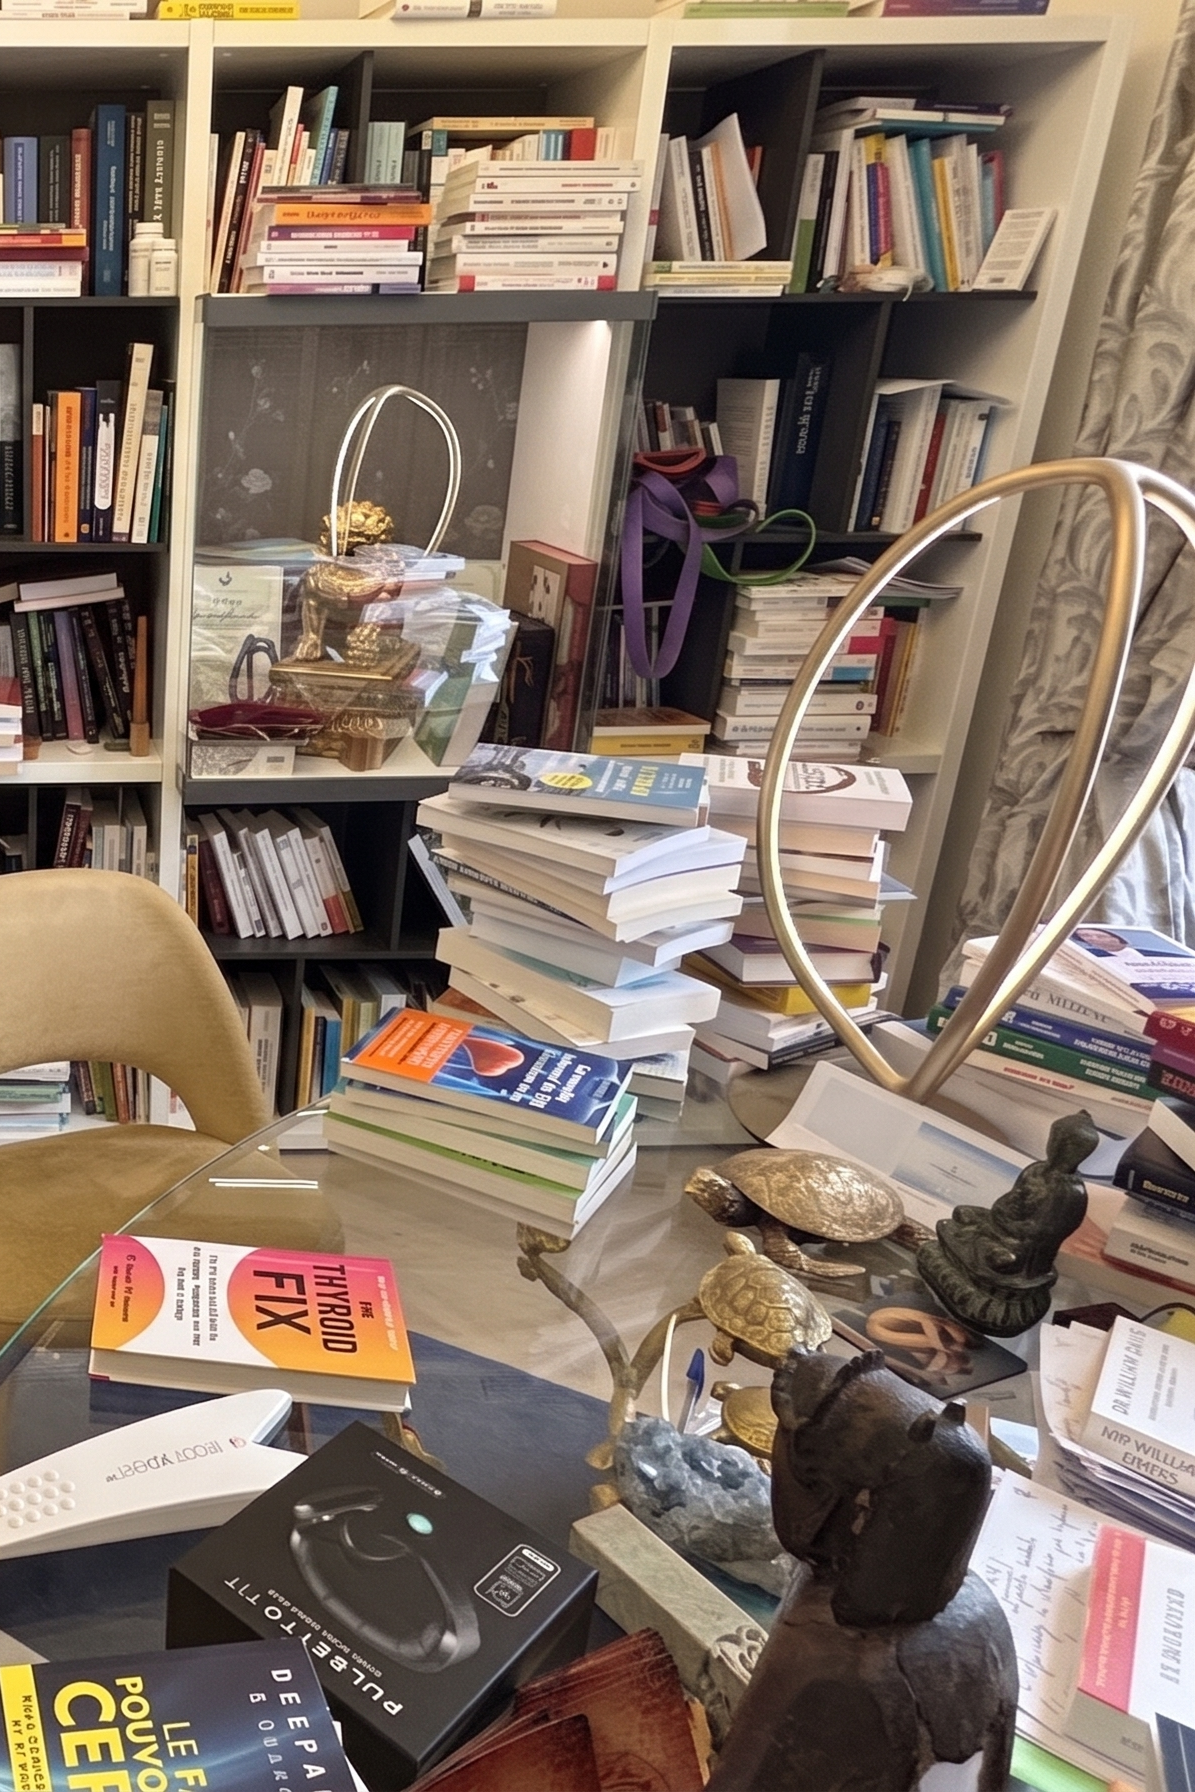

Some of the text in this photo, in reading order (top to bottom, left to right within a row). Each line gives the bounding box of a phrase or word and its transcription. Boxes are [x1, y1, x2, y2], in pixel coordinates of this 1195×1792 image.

[253, 1269, 312, 1336] FIX
[312, 1264, 358, 1354] THYROID
[162, 1721, 199, 1758] LE
